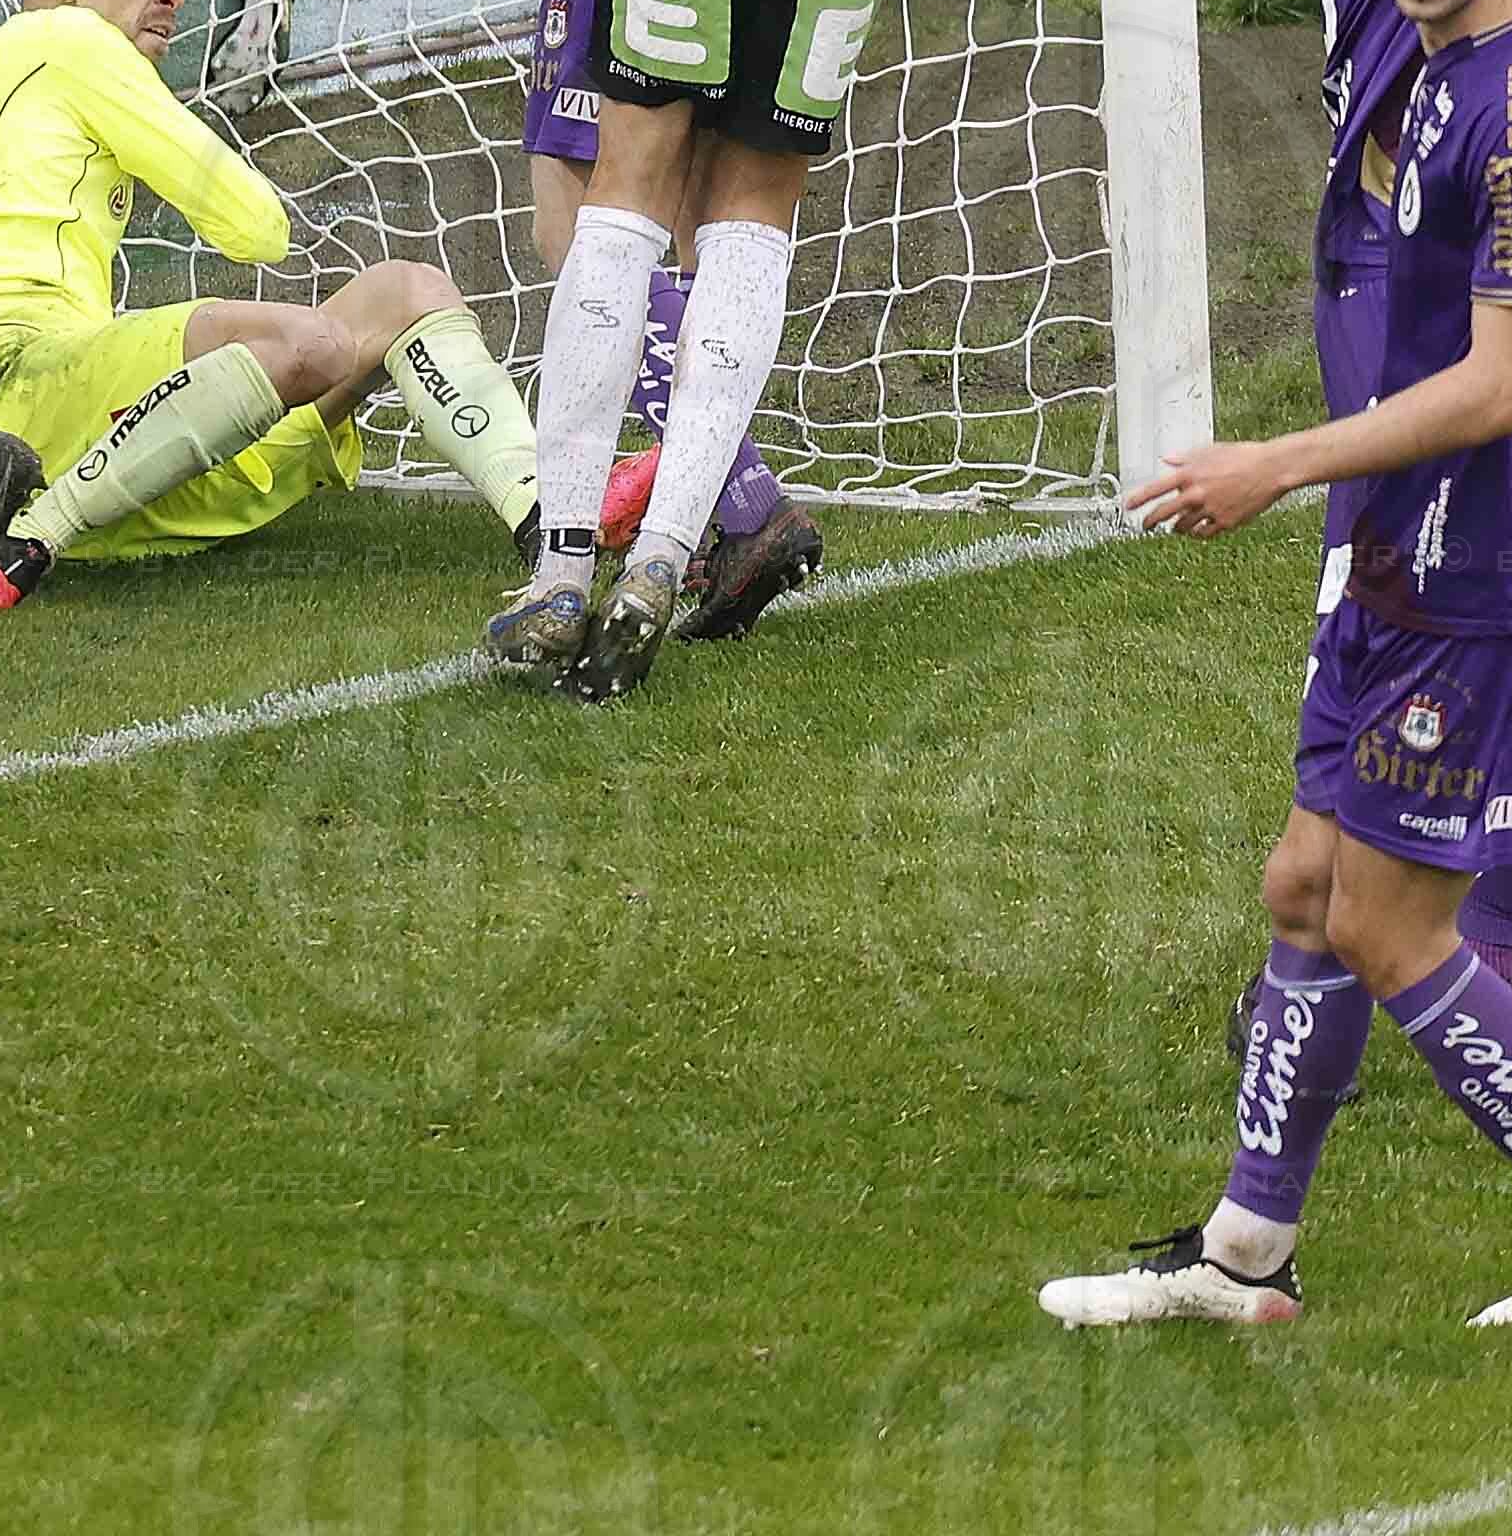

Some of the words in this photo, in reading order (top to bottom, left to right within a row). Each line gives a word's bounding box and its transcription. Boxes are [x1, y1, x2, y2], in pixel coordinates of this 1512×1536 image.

[560, 90, 601, 119] VIV
[405, 337, 461, 408] mazda
[107, 368, 192, 450] mazda
